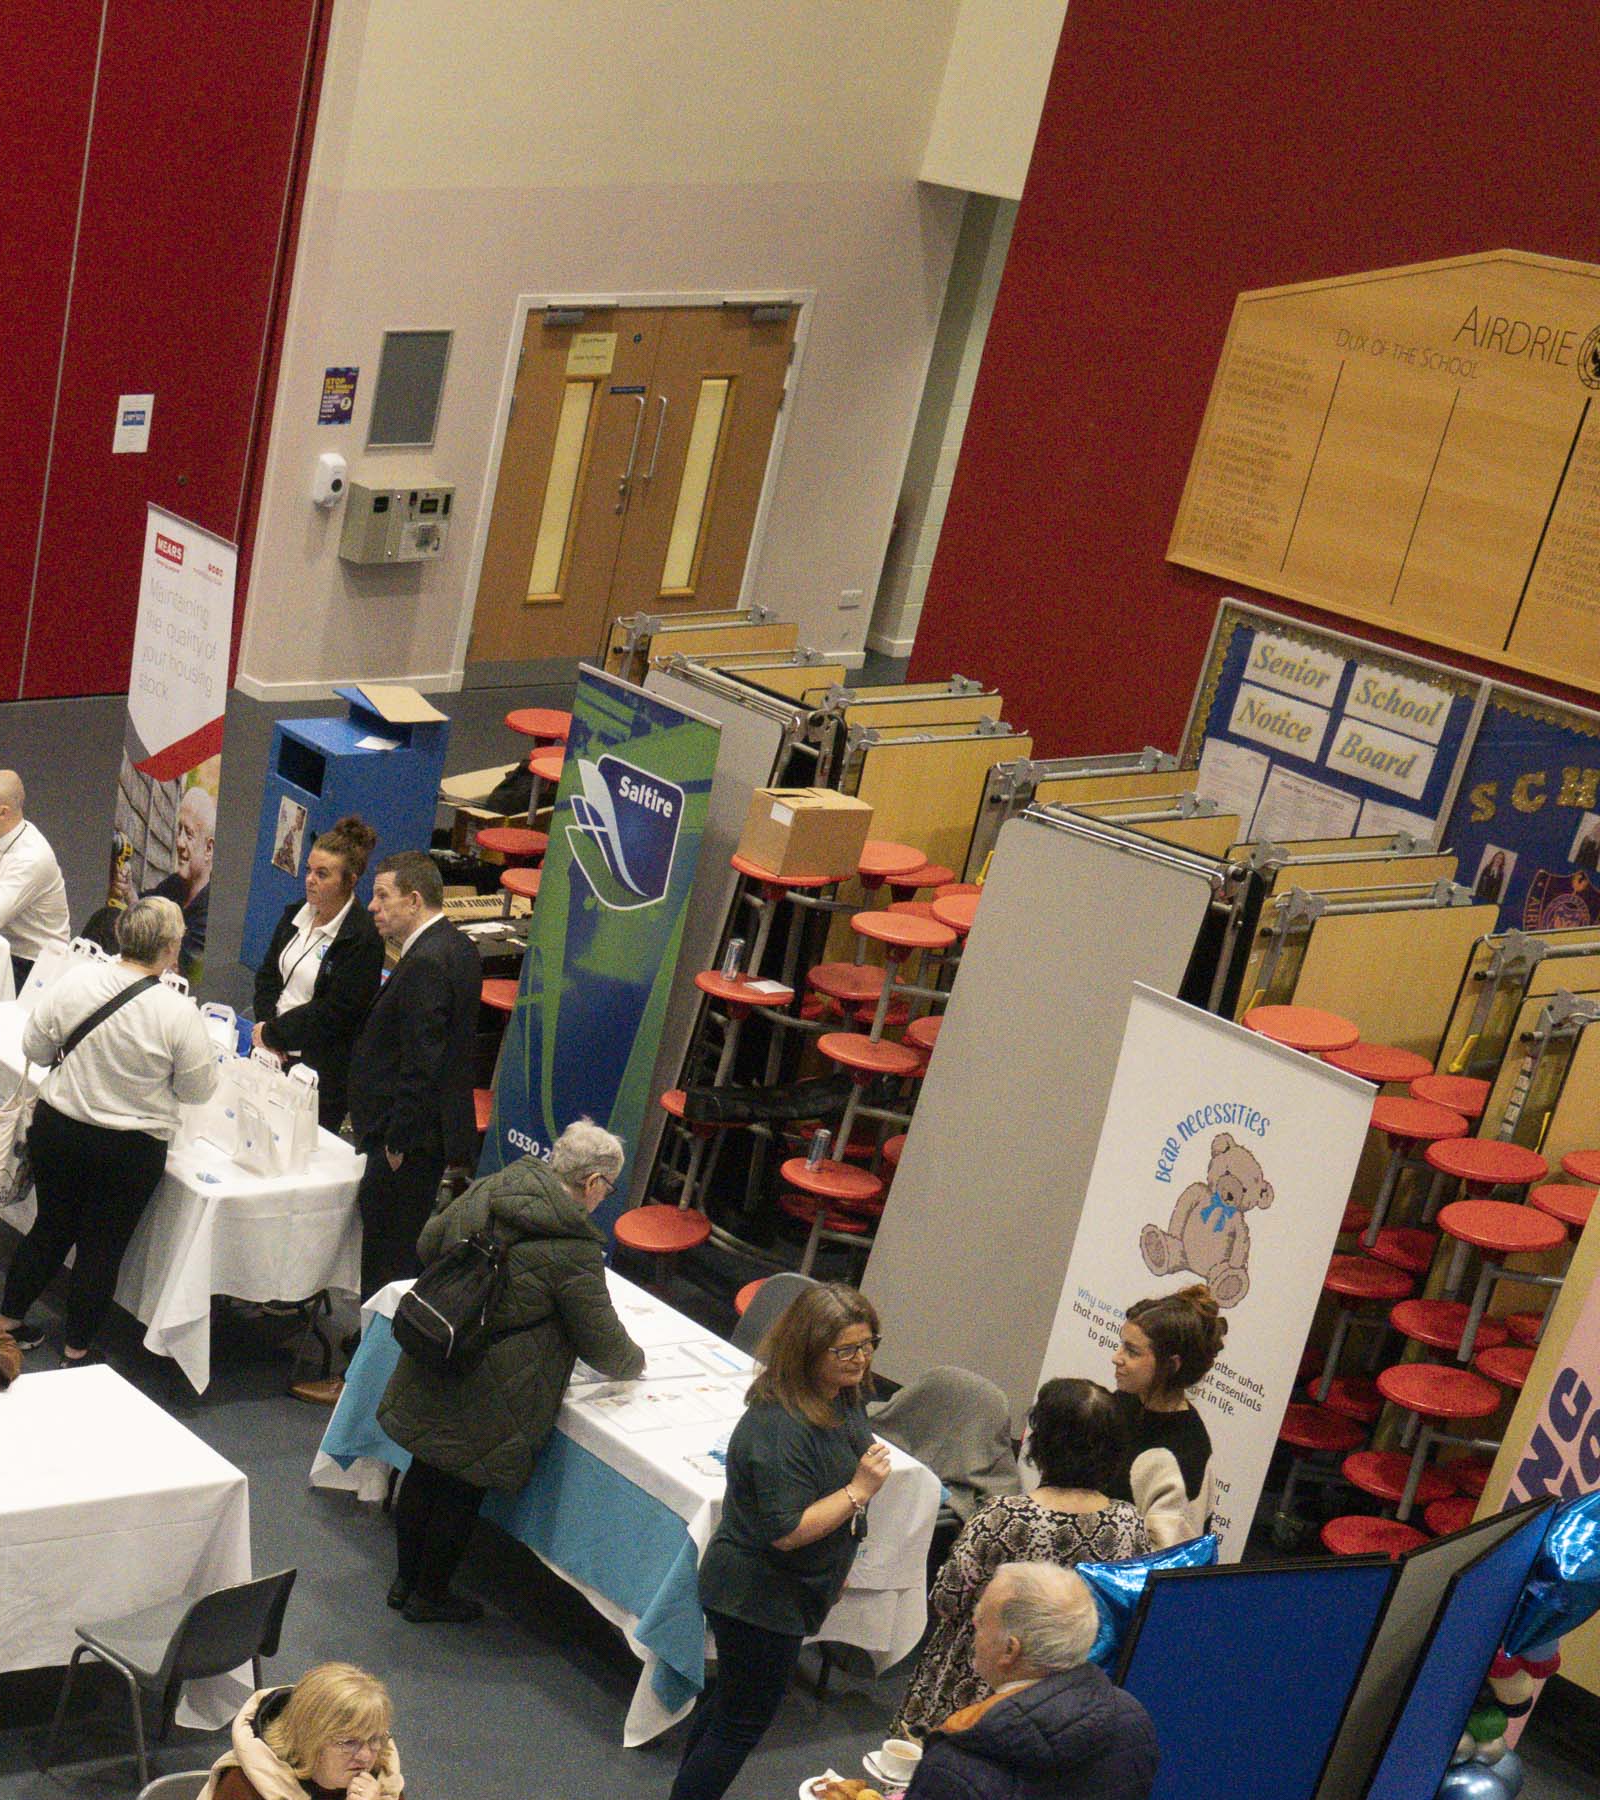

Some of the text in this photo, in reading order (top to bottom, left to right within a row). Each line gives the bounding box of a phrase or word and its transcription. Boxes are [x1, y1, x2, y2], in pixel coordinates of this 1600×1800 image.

[1453, 305, 1578, 366] AIRDRIE
[156, 536, 182, 561] MEARS
[1253, 643, 1445, 728] Senior School
[1236, 698, 1420, 780] Notice Board
[618, 774, 674, 819] Saltire
[507, 1127, 541, 1157] 0330
[1072, 1301, 1092, 1320] that
[1092, 1313, 1104, 1327] no
[1076, 1286, 1097, 1308] Why
[1097, 1299, 1113, 1315] we
[1087, 1326, 1120, 1353] to give
[1214, 1360, 1266, 1398] atter what,
[1206, 1394, 1217, 1406] in
[1217, 1399, 1236, 1417] life.
[1214, 1378, 1263, 1413] essentials
